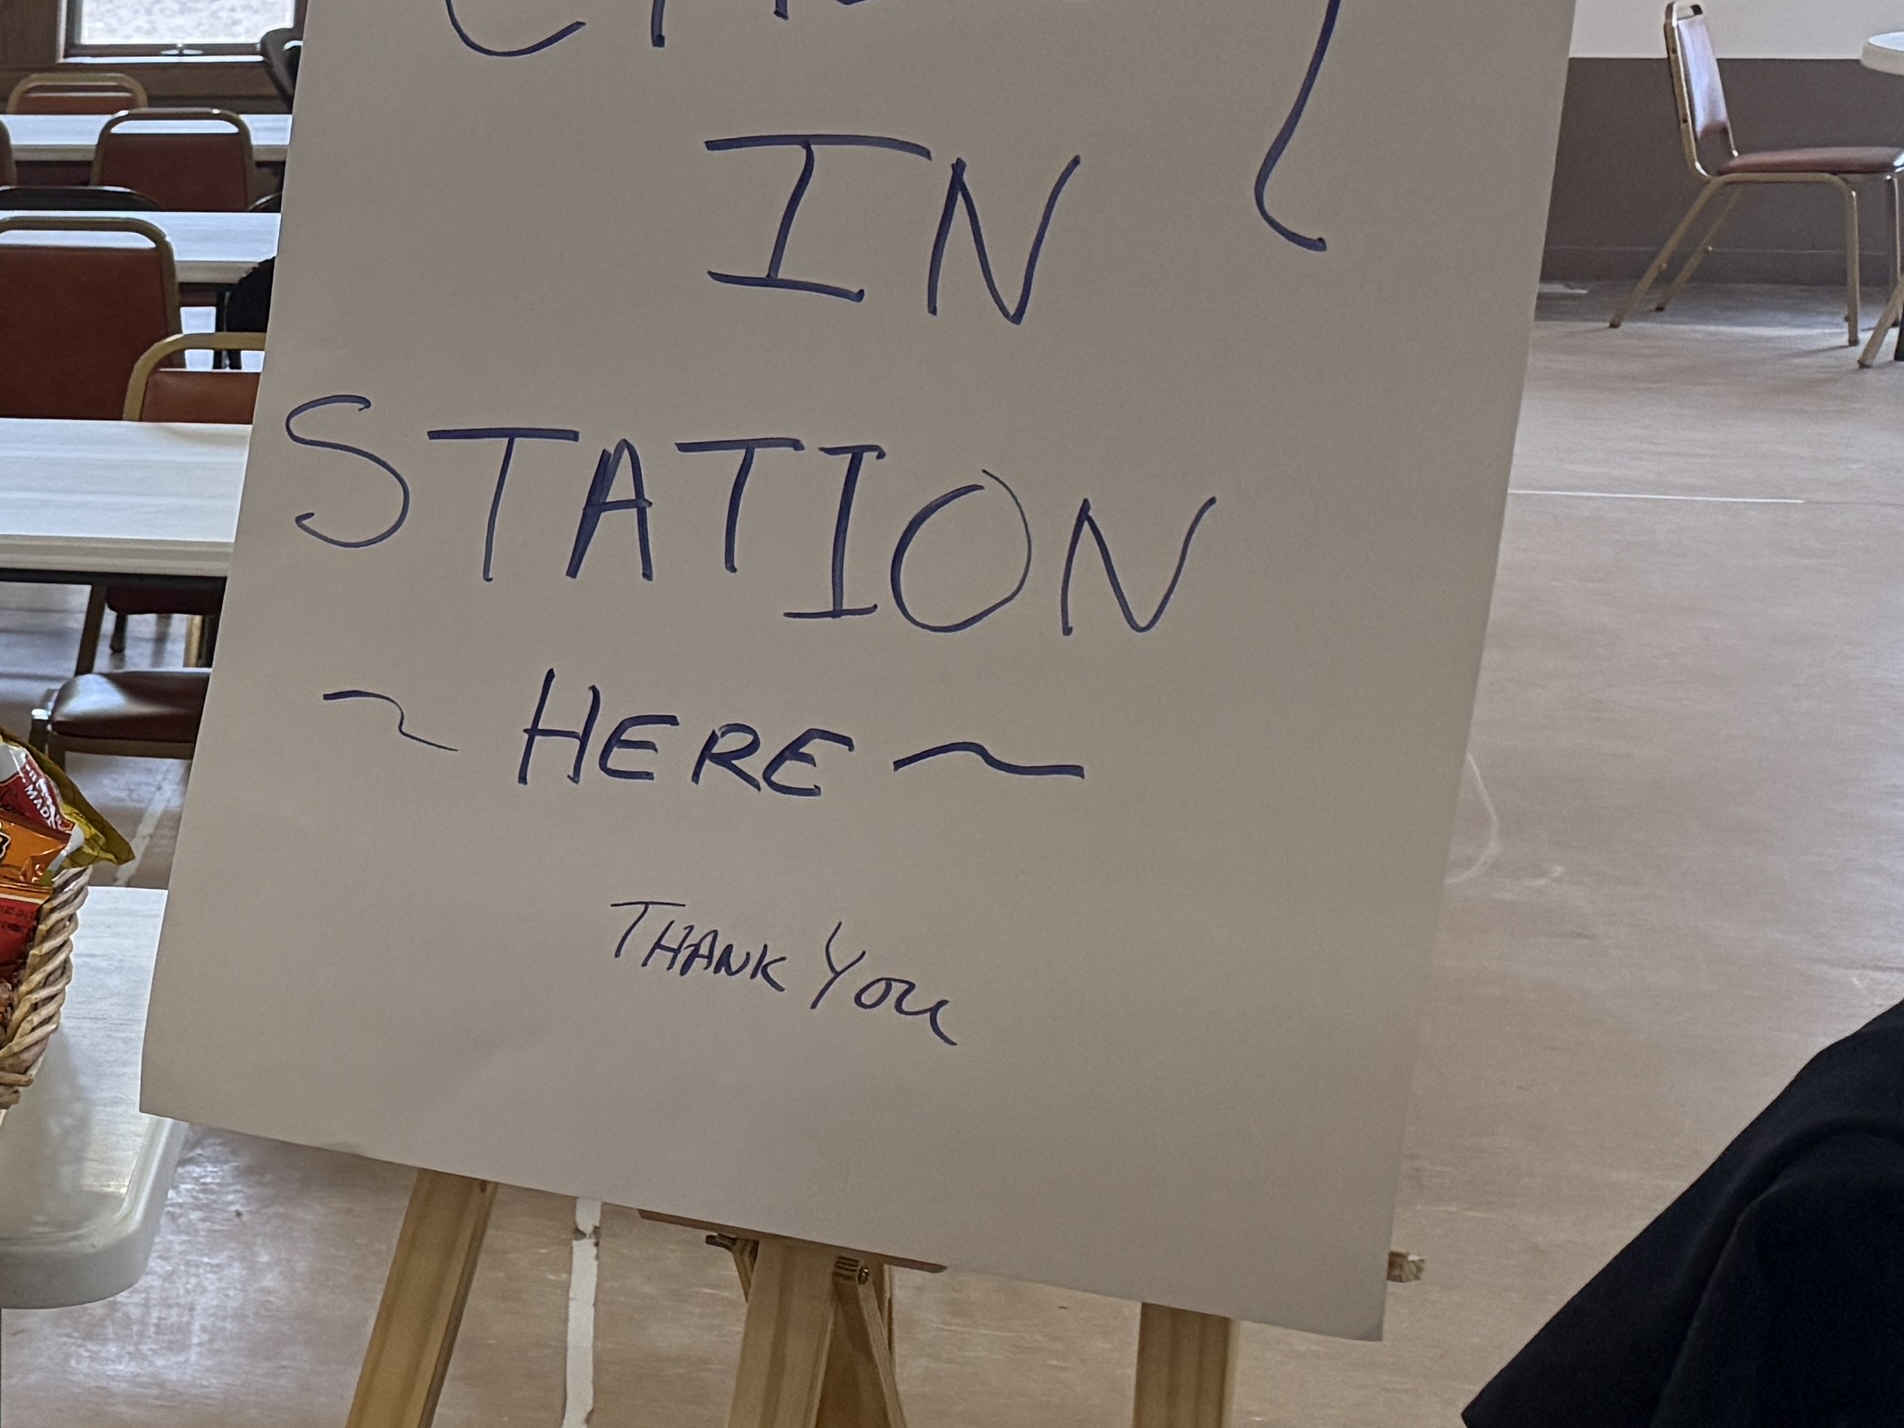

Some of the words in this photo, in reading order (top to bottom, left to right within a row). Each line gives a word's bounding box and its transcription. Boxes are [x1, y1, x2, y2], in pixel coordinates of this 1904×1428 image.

[703, 133, 1083, 324] IN
[284, 392, 1218, 637] STATION
[515, 668, 859, 800] HERE
[610, 898, 791, 997] THANK
